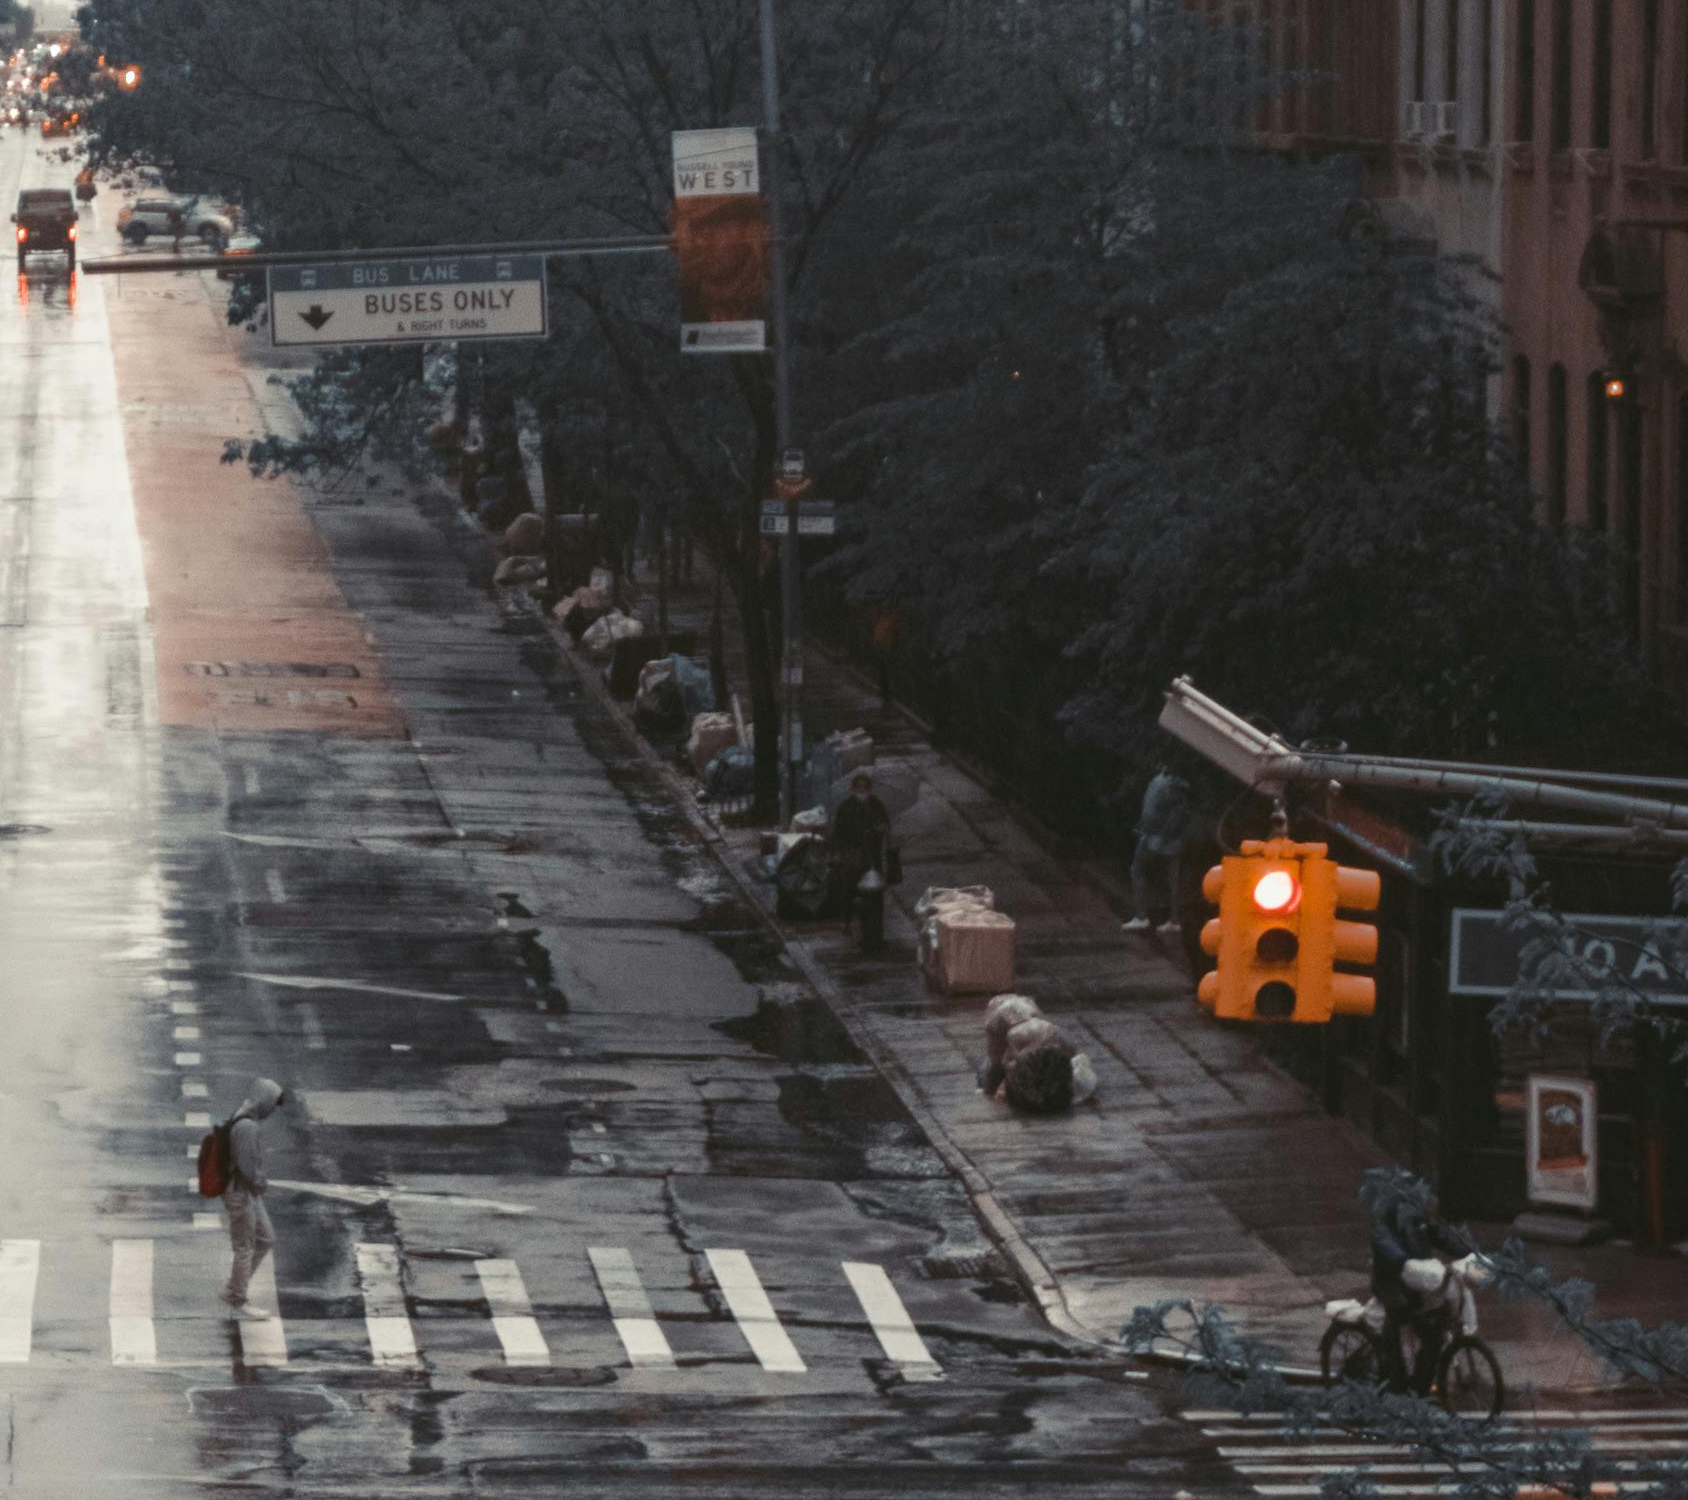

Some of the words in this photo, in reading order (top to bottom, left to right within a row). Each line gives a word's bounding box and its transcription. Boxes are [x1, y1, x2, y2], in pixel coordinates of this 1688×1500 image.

[677, 170, 753, 190] WEST
[352, 266, 390, 285] BUS
[409, 264, 459, 282] LANE
[365, 291, 443, 314] BUSES
[453, 288, 515, 310] ONLY
[397, 321, 405, 332] &
[411, 319, 443, 332] RIGHT
[449, 317, 487, 329] TURNS
